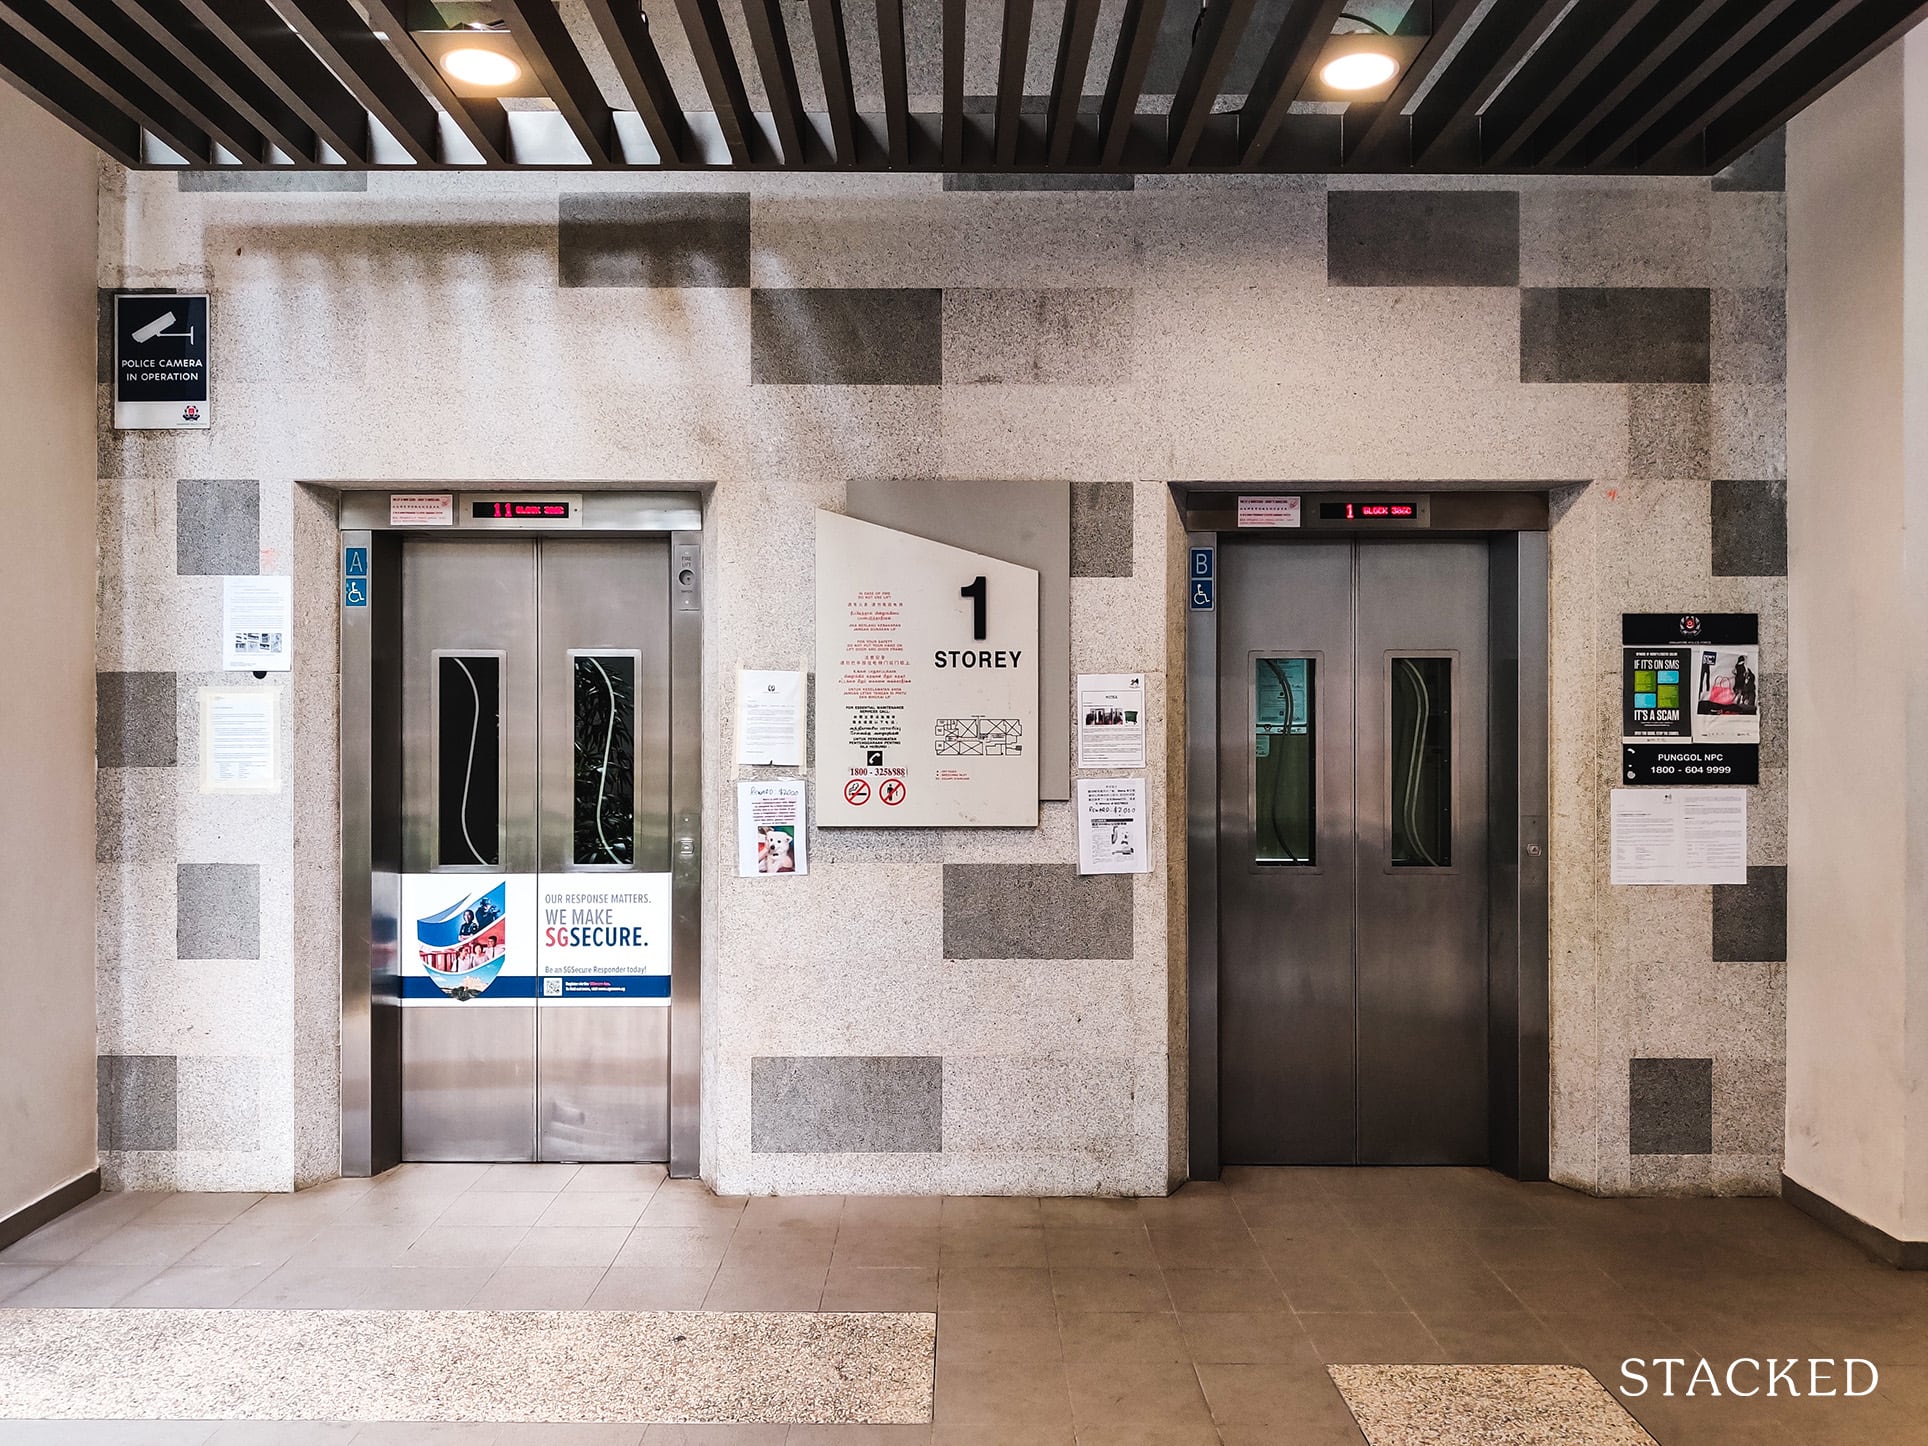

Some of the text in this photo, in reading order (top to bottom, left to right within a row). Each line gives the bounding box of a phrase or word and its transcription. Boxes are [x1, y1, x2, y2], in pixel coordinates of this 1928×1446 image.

[121, 359, 203, 368] POLICE CAMERA
[126, 373, 199, 381] IN OPERATION
[1346, 503, 1354, 519] 1
[1362, 506, 1388, 515] BLOCK
[350, 551, 363, 572] A
[1196, 553, 1208, 574] B
[961, 576, 986, 640] 1
[934, 650, 1022, 668] STOREY
[1634, 660, 1680, 670] IF IT'S ON SMS
[1634, 709, 1680, 721] IT'S A SCAM
[1658, 753, 1723, 761] PUNGGOL NPC
[850, 768, 868, 776] 1800
[1650, 766, 1675, 774] 1800
[1685, 766, 1704, 774] 604
[1706, 766, 1732, 774] 9999
[545, 894, 652, 904] OUR RESPONSE MATTERS.
[545, 908, 613, 925] WE MAKE
[545, 927, 648, 947] SGSECURE.
[593, 966, 626, 974] Responder
[627, 966, 647, 974] today!
